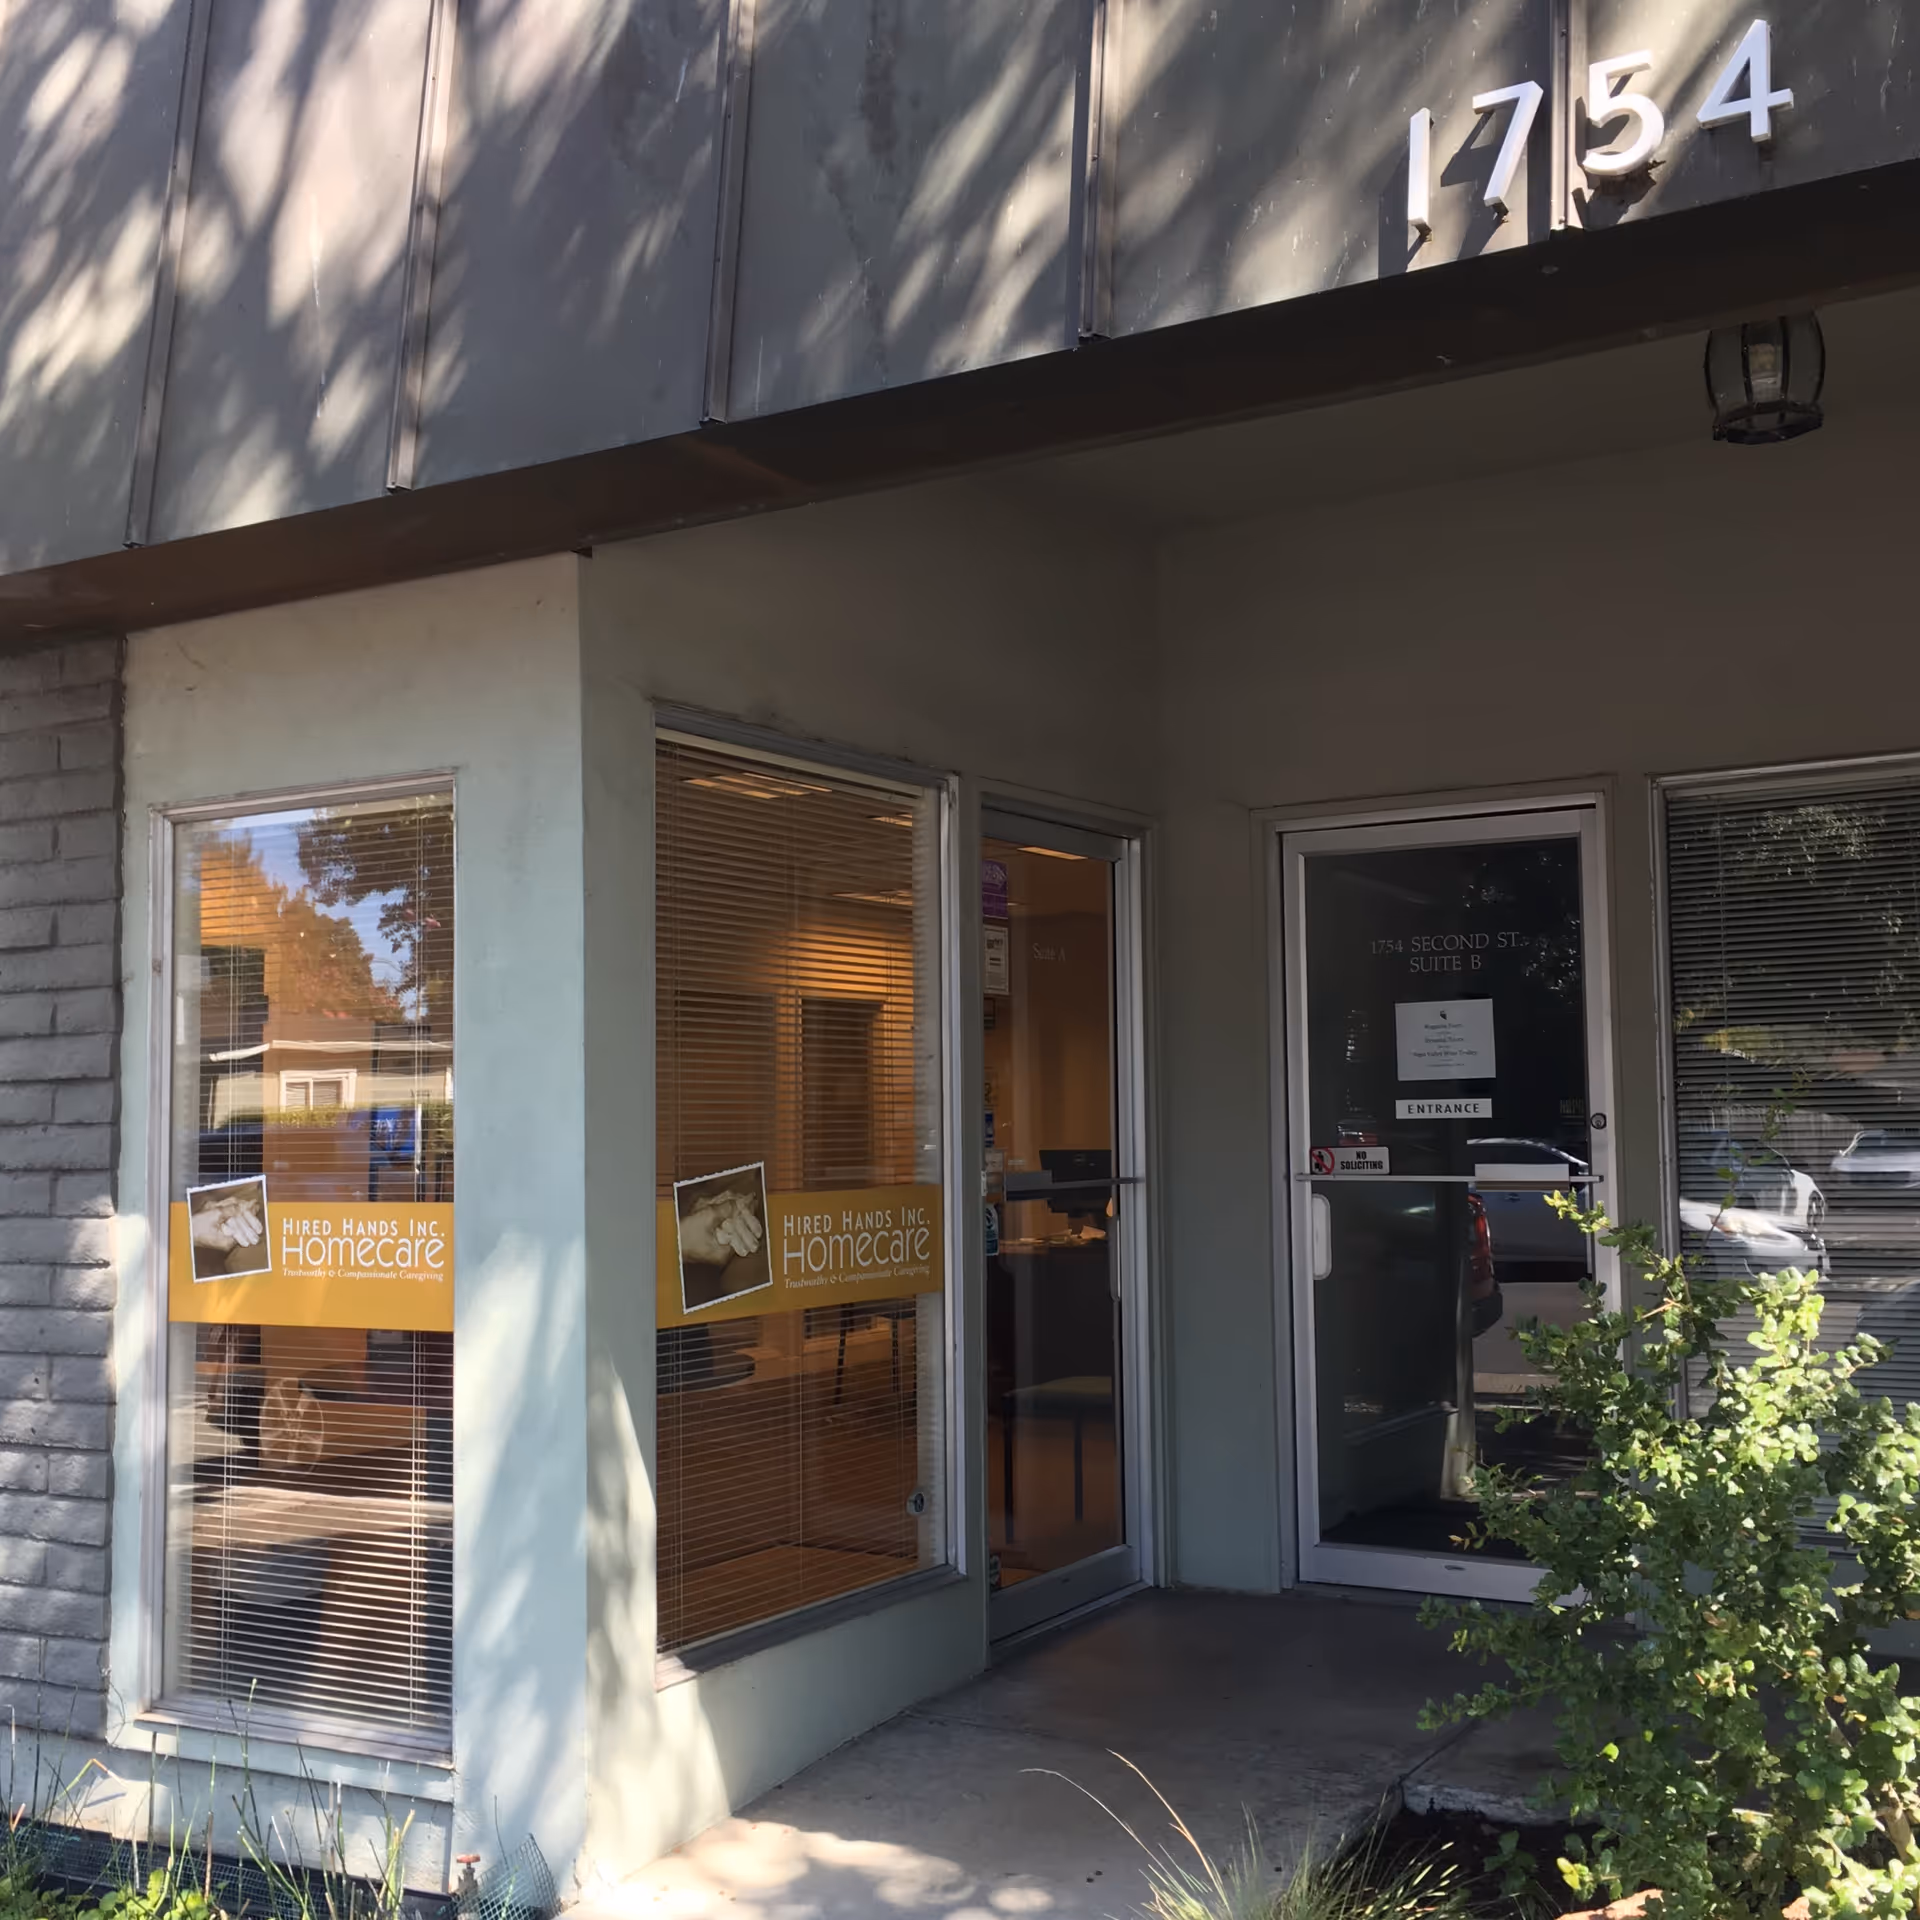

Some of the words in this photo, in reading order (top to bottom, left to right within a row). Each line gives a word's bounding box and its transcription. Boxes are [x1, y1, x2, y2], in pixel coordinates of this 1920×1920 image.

[1407, 18, 1794, 226] 1754
[1411, 933, 1489, 952] SECOND
[1410, 956, 1461, 972] SUITE
[1471, 954, 1482, 970] B
[1407, 1102, 1480, 1115] ENTRANCE
[1355, 1150, 1367, 1160] NO
[1340, 1160, 1384, 1171] SOLICITING
[282, 1217, 332, 1236] HIRED
[342, 1217, 398, 1237] HANDS
[409, 1218, 445, 1238] INC.
[783, 1214, 833, 1237] HIRED
[842, 1209, 892, 1232] HANDS
[282, 1236, 445, 1268] Homecare
[783, 1227, 930, 1275] Homecare
[399, 1270, 444, 1282] Caregiving
